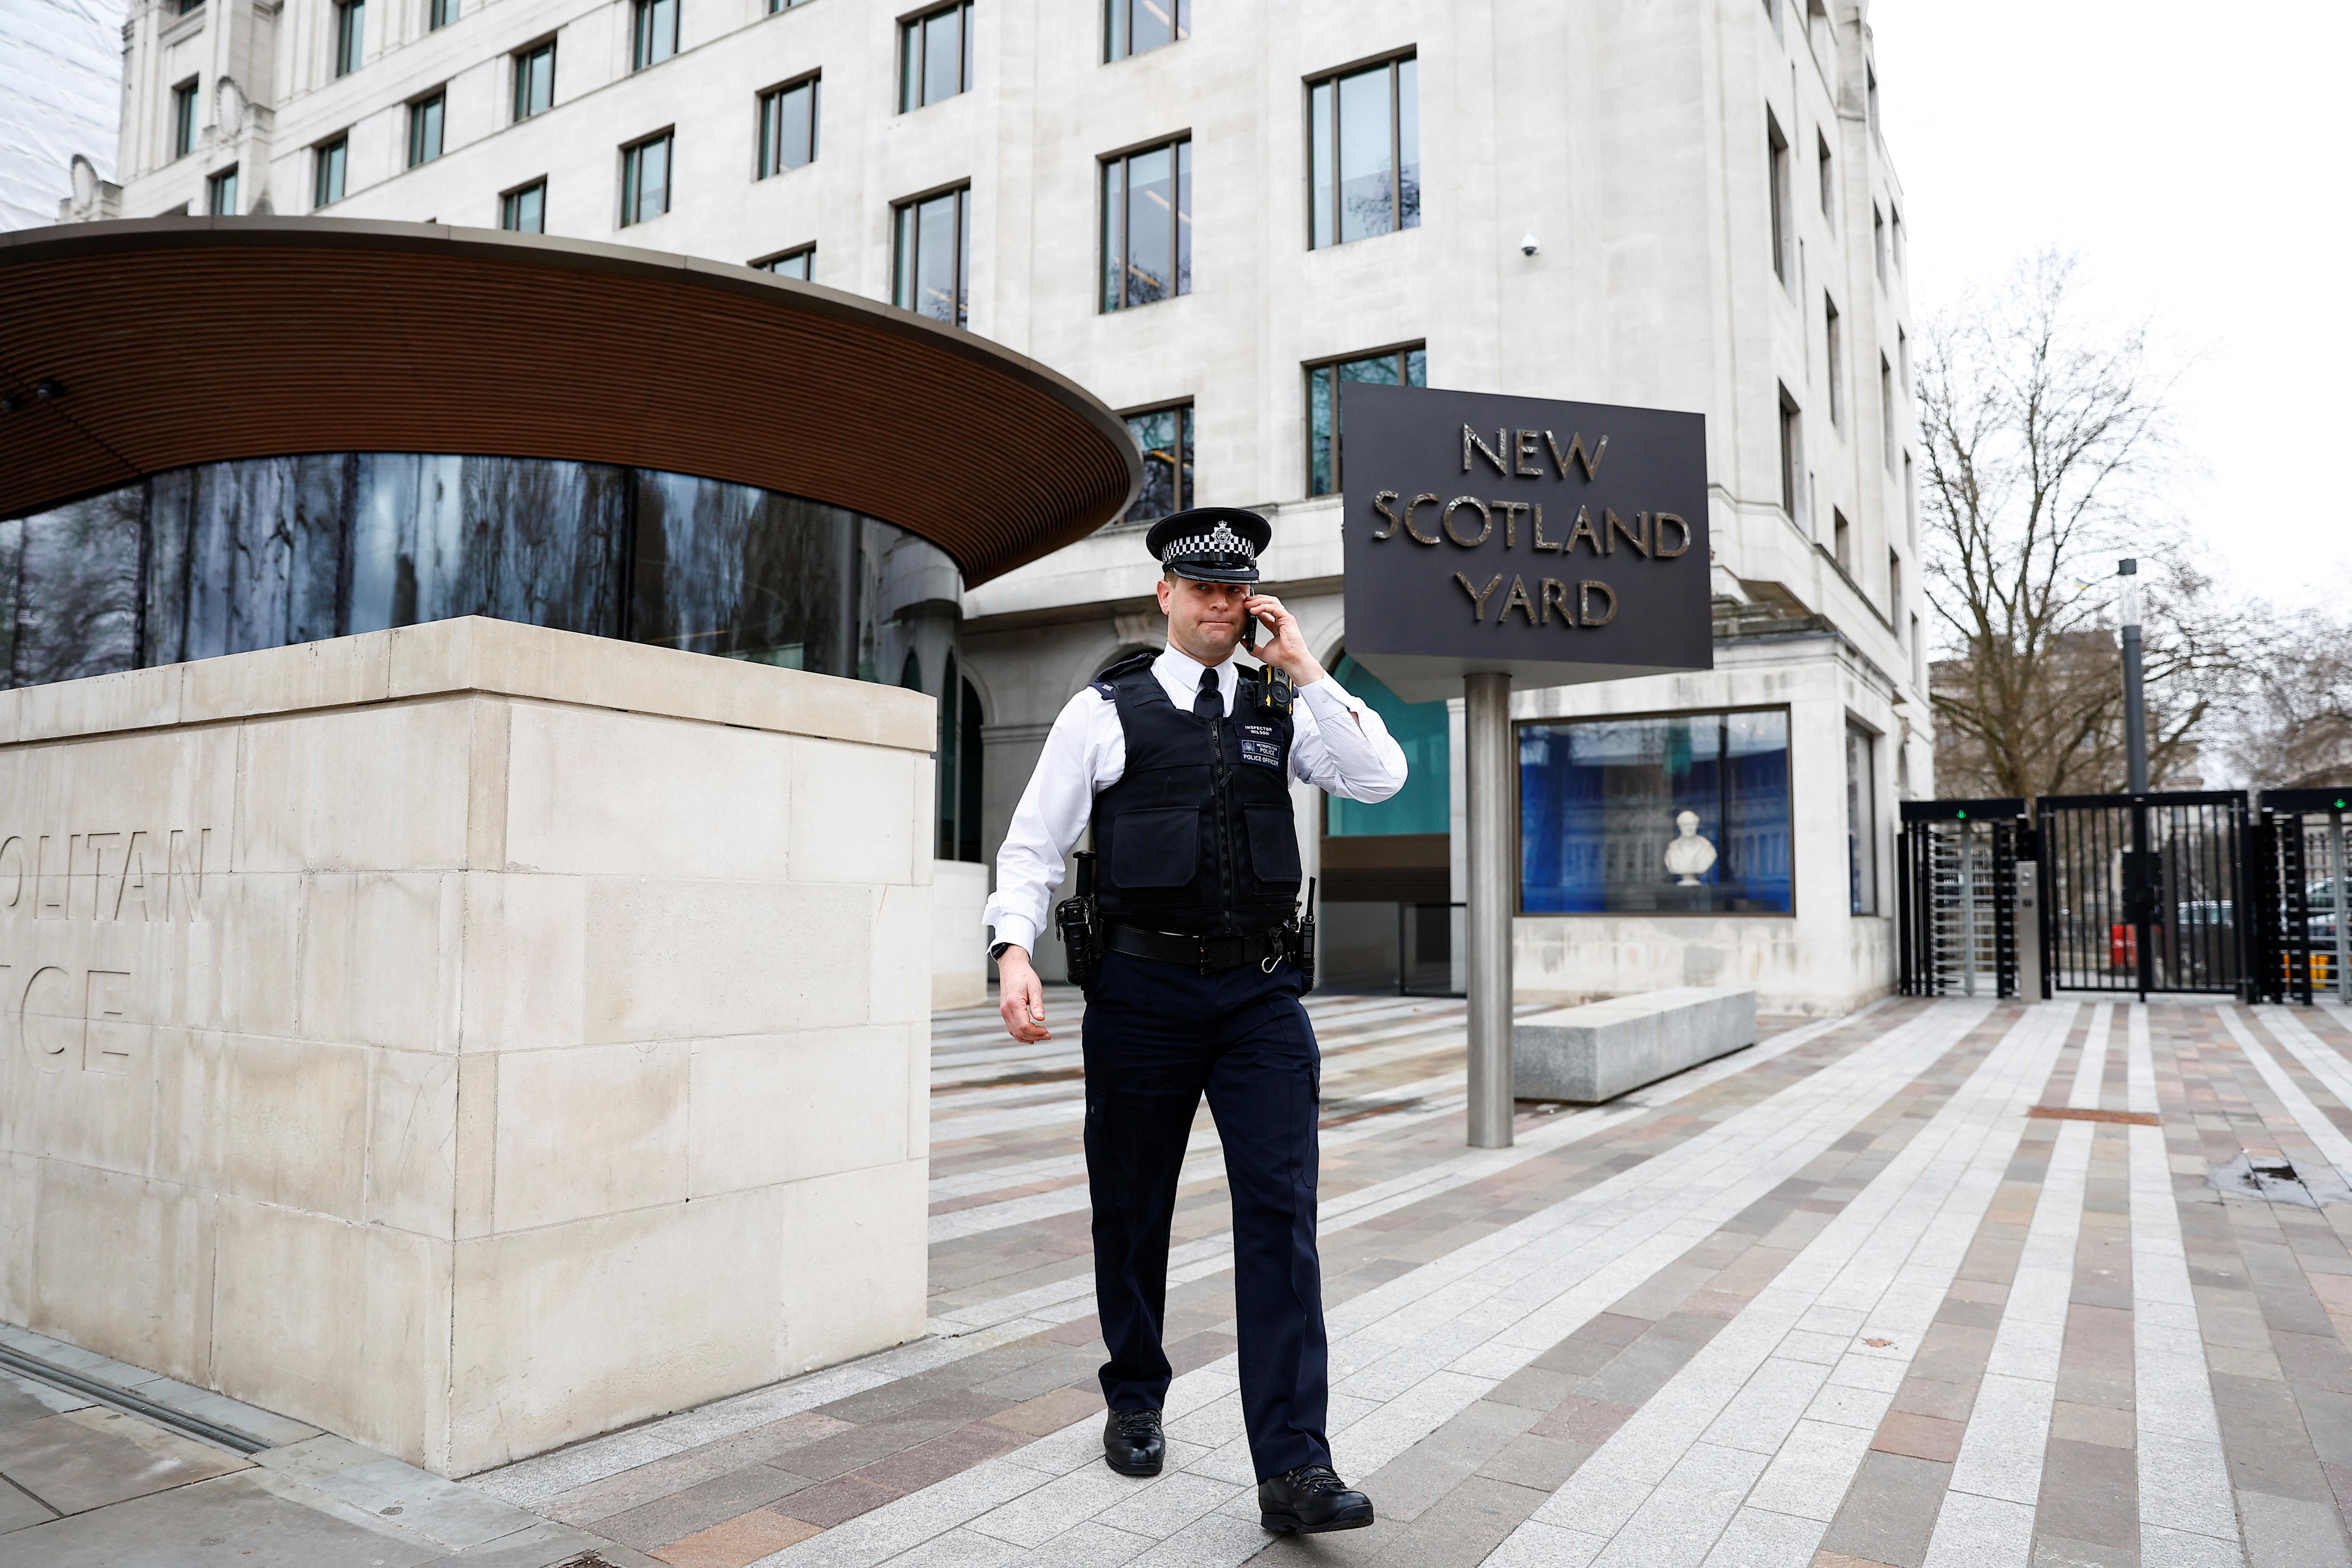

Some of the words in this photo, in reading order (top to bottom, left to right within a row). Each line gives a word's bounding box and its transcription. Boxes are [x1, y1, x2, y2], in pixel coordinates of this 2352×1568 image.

[1461, 422, 1609, 482] NEW
[1372, 490, 1692, 558] SCOTLAND
[1454, 571, 1617, 628] YARD
[1260, 748, 1275, 756] POLICE
[1262, 757, 1279, 767] OFFICER
